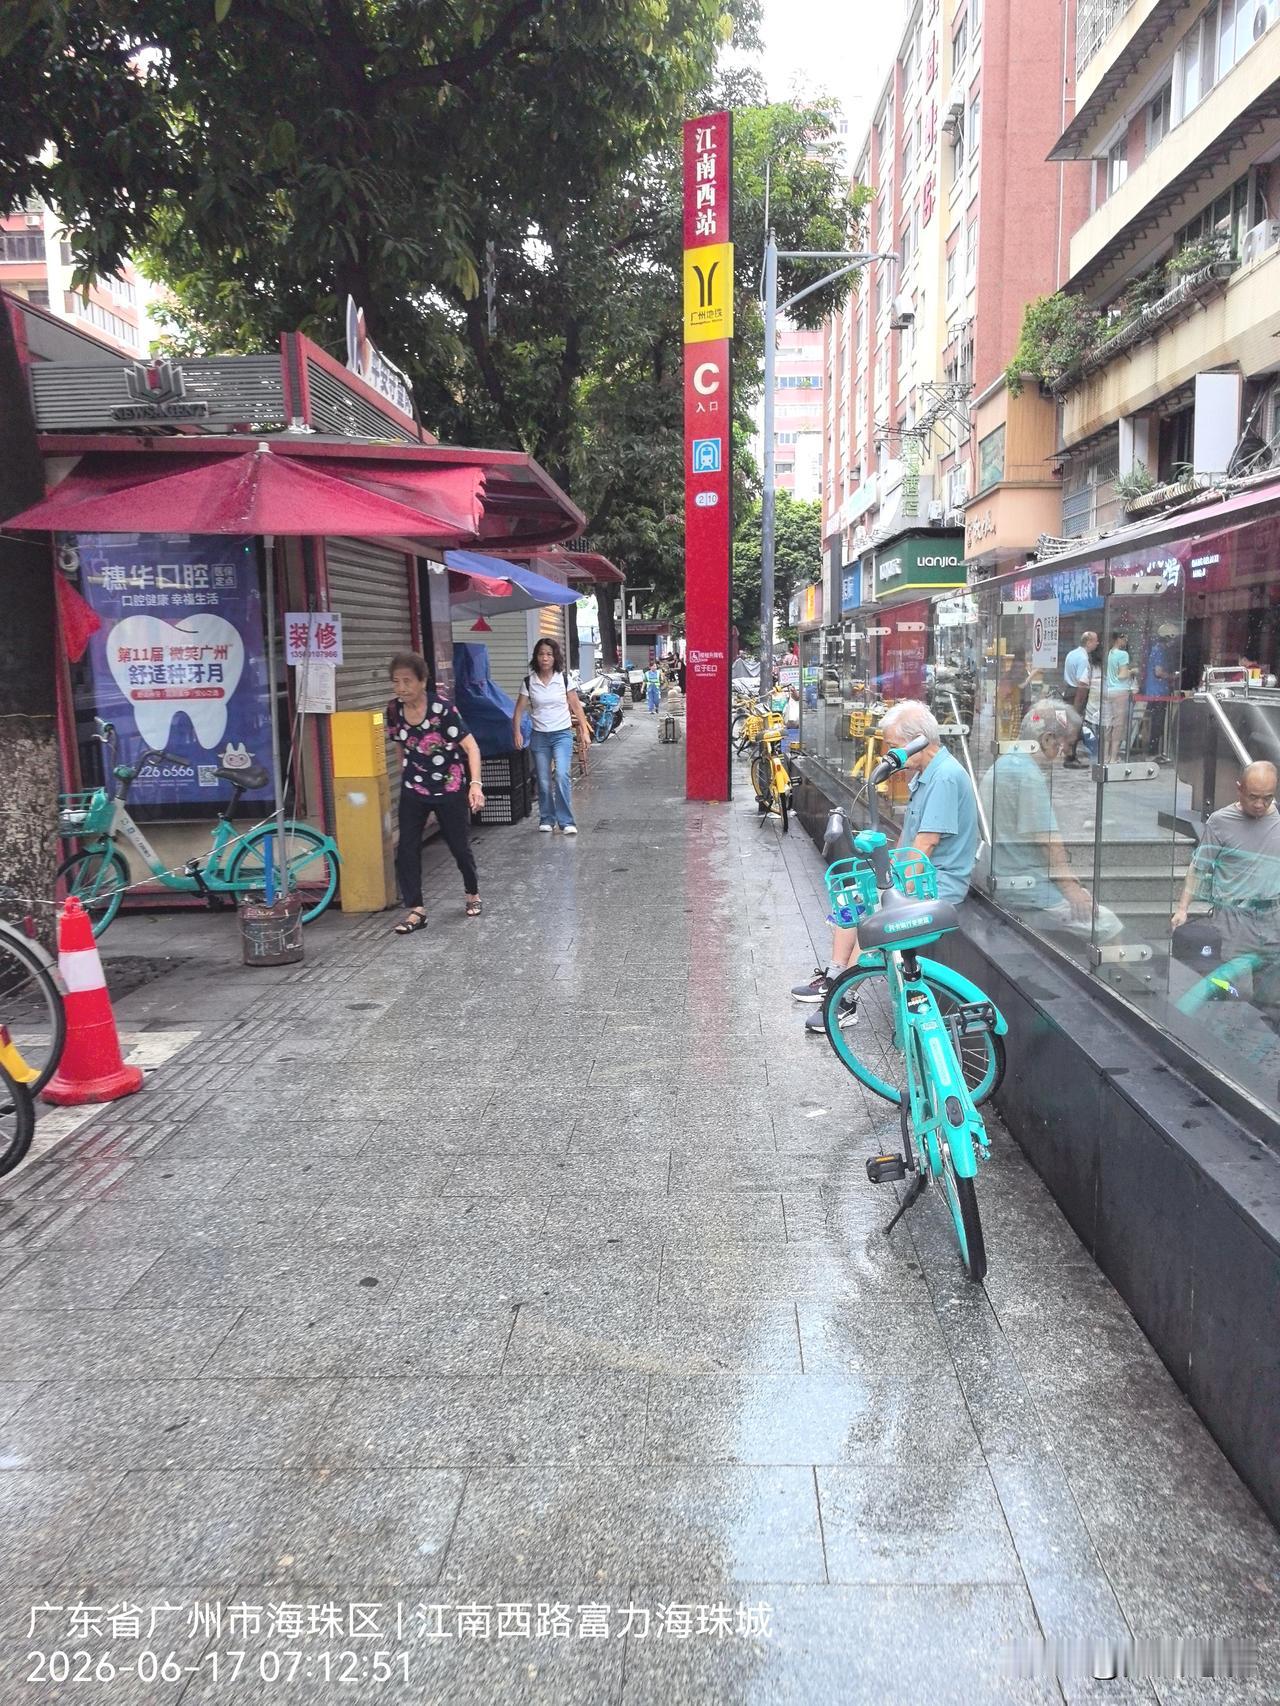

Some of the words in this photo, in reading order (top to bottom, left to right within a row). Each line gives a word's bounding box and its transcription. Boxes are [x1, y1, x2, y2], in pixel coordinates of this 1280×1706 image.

[694, 125, 717, 237] 江南西站
[690, 308, 723, 322] 广州地铁
[693, 362, 720, 397] C
[695, 401, 719, 413] 入口
[708, 494, 718, 503] 10
[101, 563, 210, 591] 穗华口腔
[214, 576, 234, 587] 定点
[121, 594, 169, 607] 口腔健康
[171, 592, 219, 606] 幸福生活
[289, 622, 337, 650] 装修
[128, 663, 224, 686] 舒适种牙月
